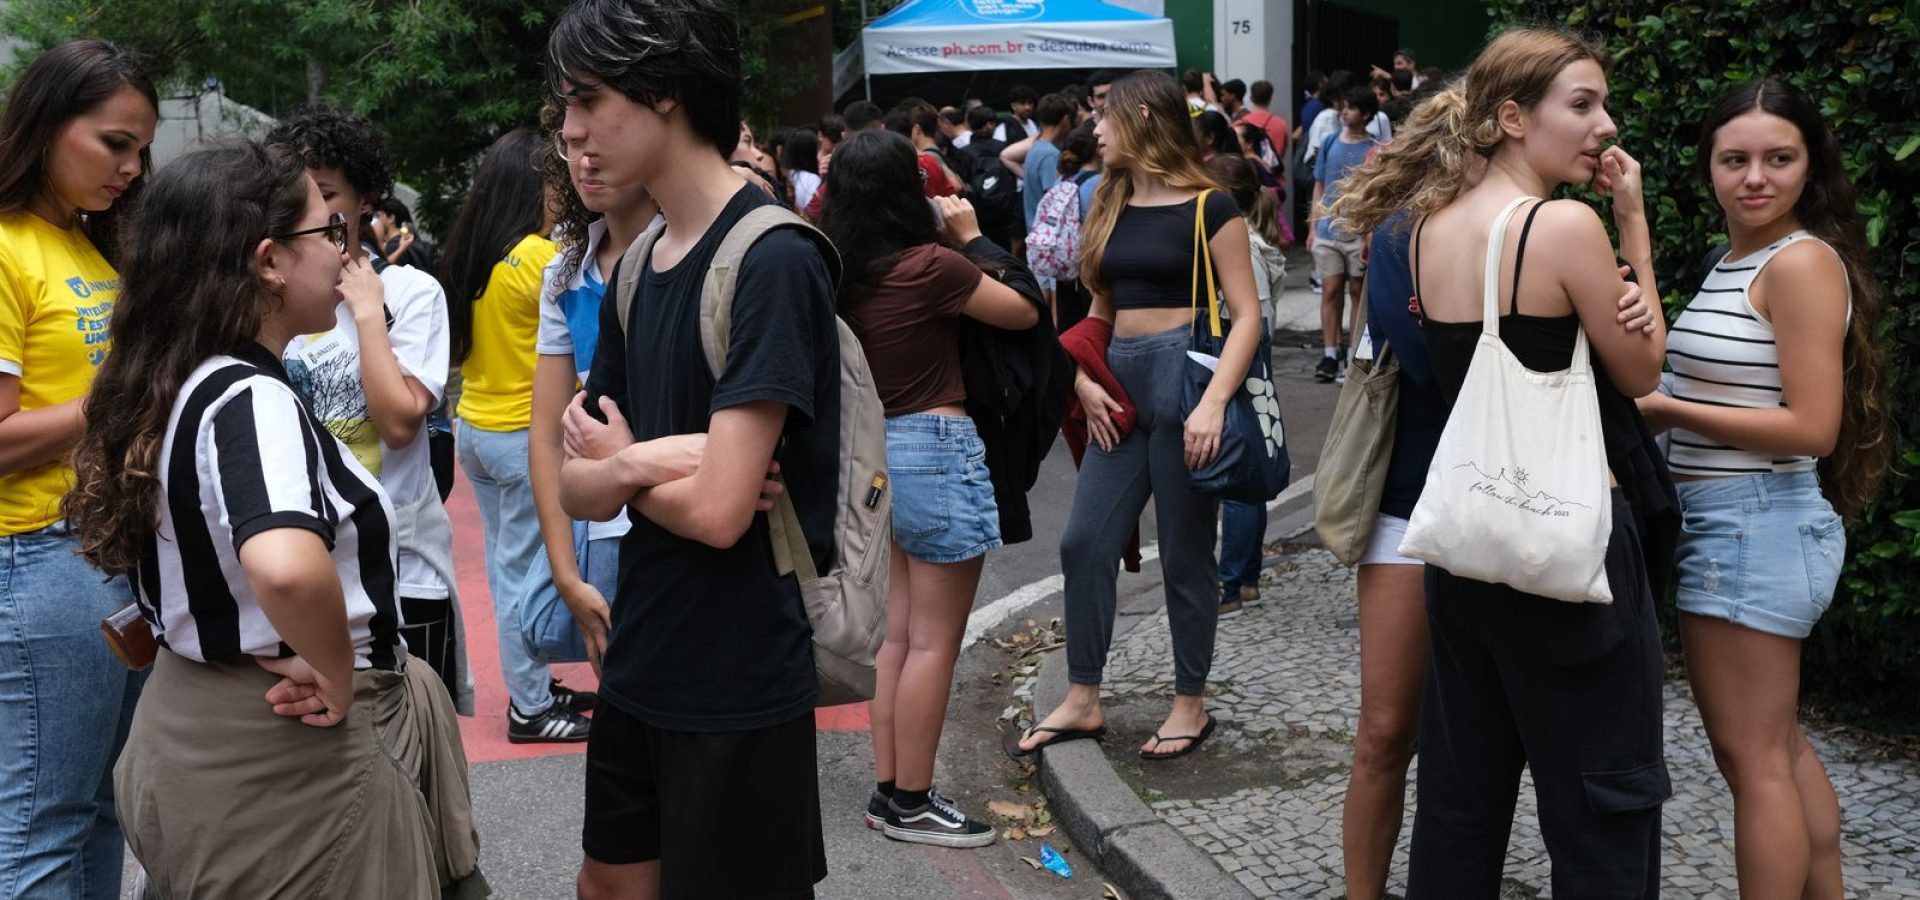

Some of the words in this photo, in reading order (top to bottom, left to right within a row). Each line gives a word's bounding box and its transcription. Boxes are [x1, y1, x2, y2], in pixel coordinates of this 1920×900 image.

[1232, 20, 1251, 35] 75
[887, 45, 938, 57] Acesse
[942, 41, 1024, 58] ph.com.br
[1027, 42, 1036, 52] e
[1039, 39, 1107, 53] descubra
[1110, 41, 1152, 53] como
[76, 317, 86, 331] É
[89, 315, 113, 331] EST
[1518, 499, 1554, 517] beach
[1554, 509, 1570, 517] 2023
